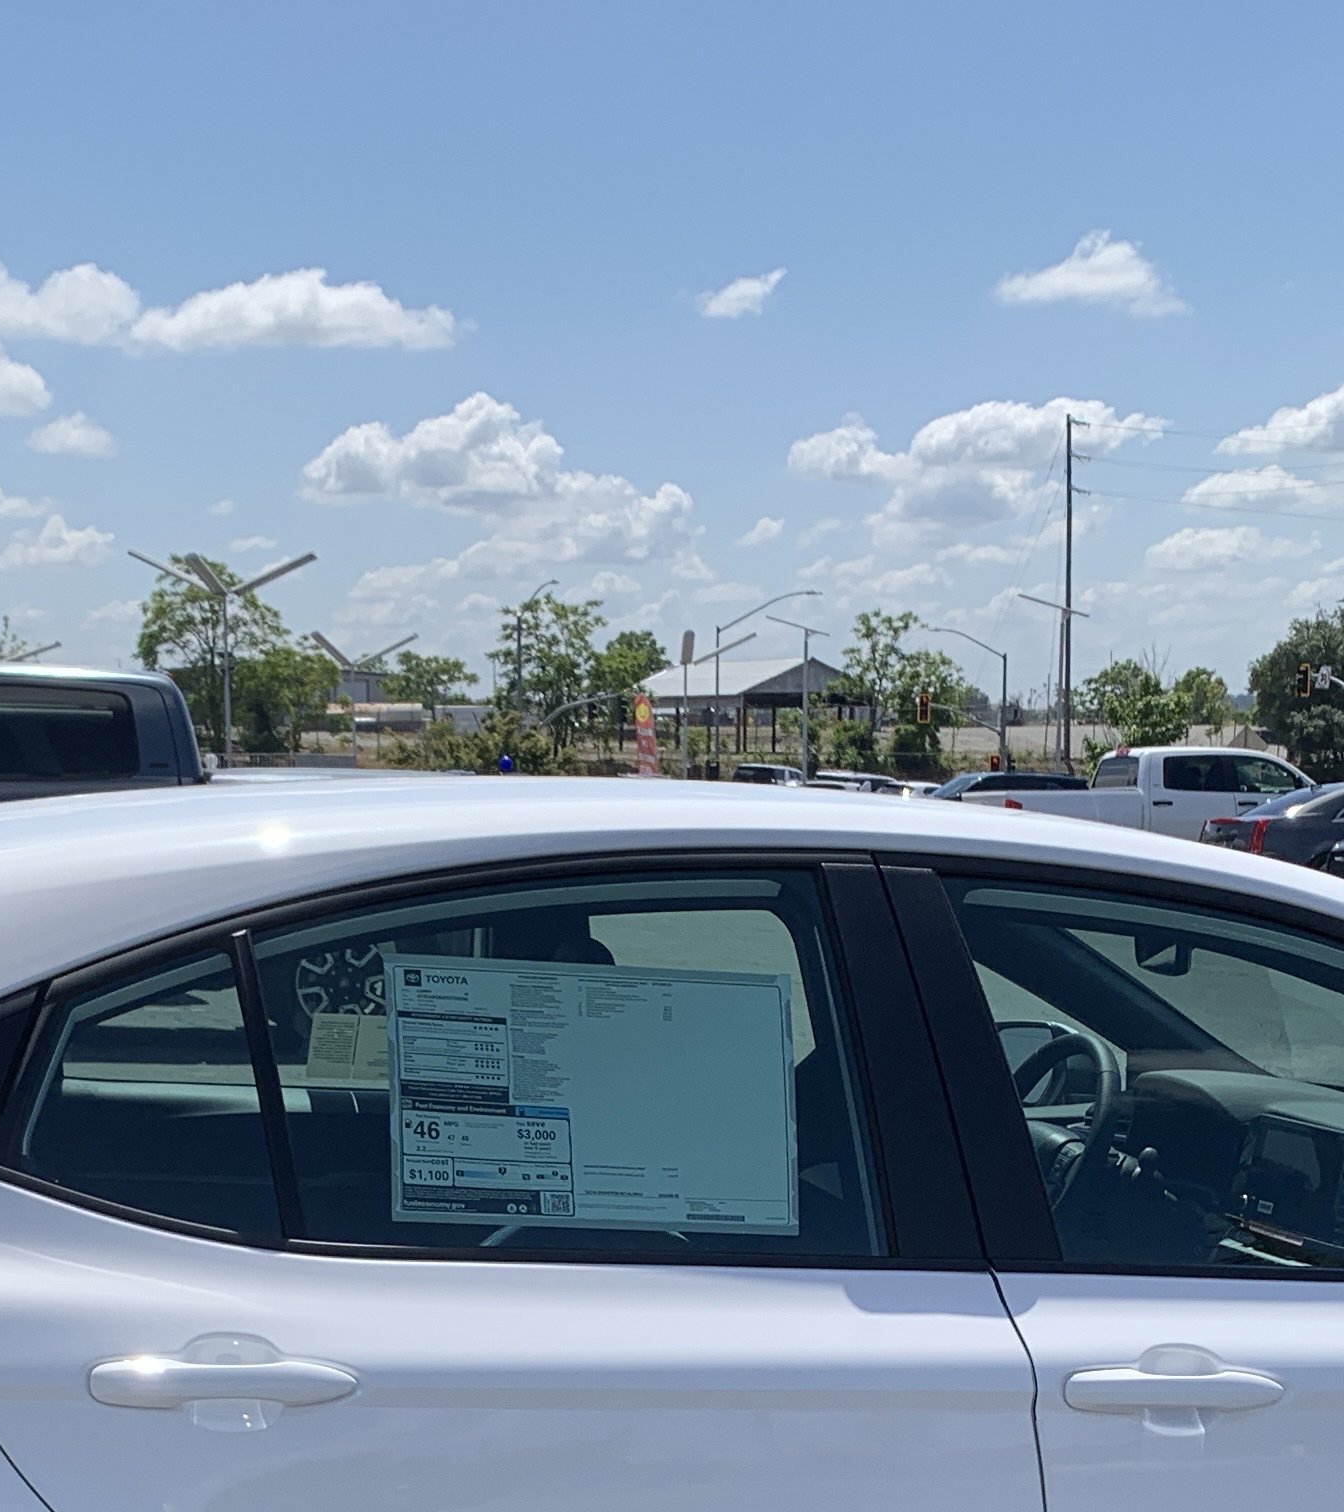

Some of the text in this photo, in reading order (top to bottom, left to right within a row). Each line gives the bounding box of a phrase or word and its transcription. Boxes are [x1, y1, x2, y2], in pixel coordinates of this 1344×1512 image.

[425, 974, 469, 987] TOYOTA
[413, 1119, 441, 1141] 46
[516, 1128, 557, 1141] $3,000
[409, 1168, 450, 1181] $1,100
